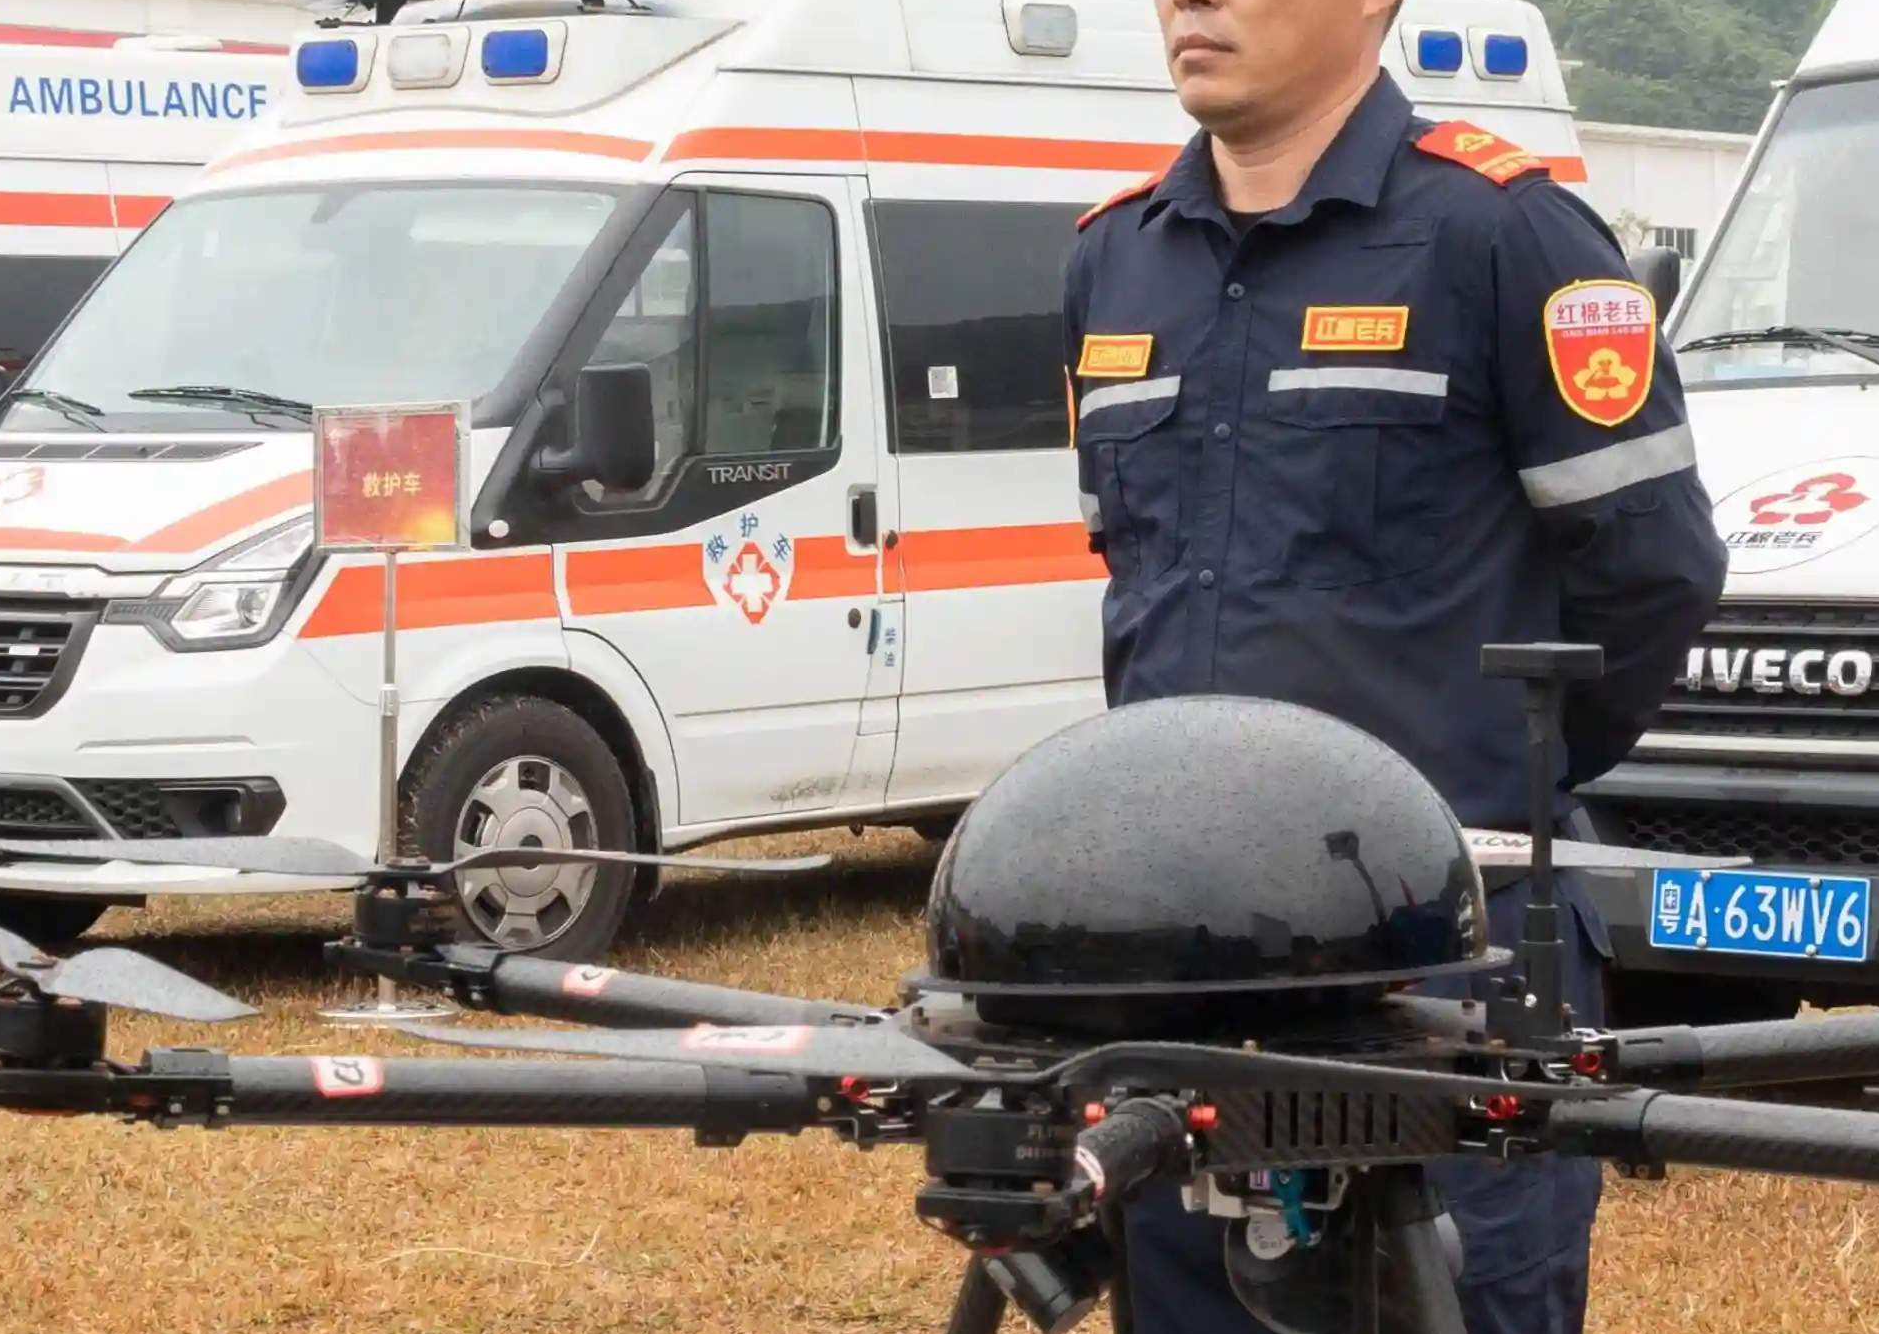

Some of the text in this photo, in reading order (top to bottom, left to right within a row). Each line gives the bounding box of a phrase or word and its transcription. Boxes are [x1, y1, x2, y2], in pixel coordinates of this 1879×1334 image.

[362, 470, 422, 499] 救护车
[707, 463, 791, 484] TRANSIT
[1686, 647, 1873, 696] IVECO
